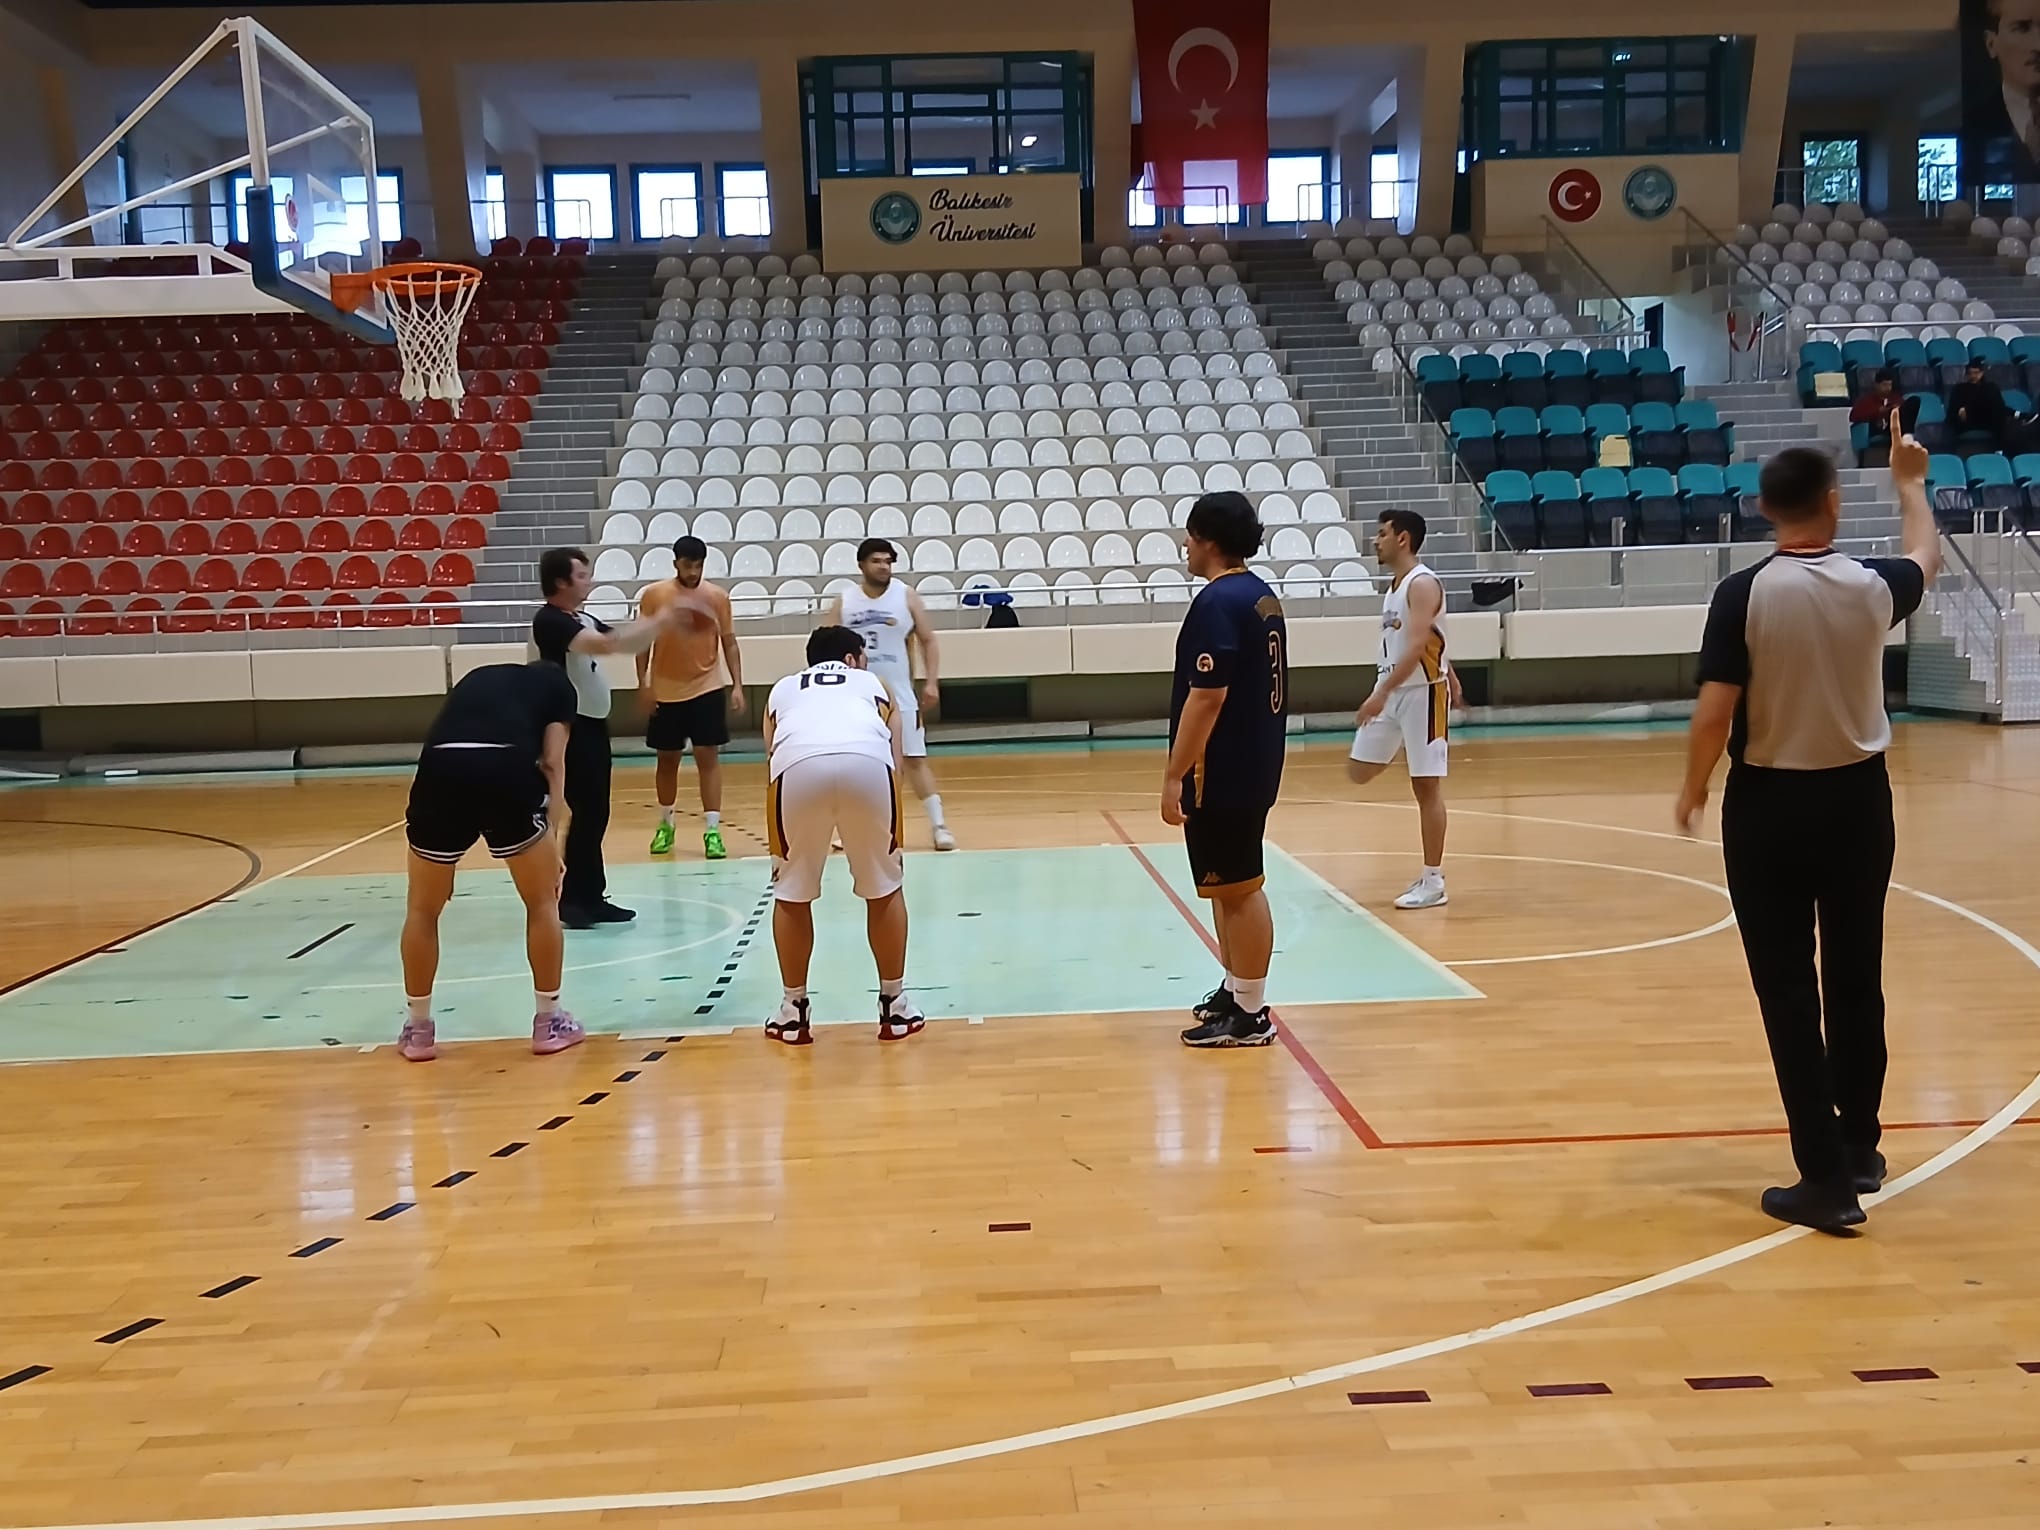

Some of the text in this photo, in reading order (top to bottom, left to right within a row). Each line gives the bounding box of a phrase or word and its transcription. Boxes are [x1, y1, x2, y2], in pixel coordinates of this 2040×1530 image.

[929, 214, 1036, 241] Üniversitesi
[800, 672, 846, 690] 10
[1268, 630, 1283, 714] 3
